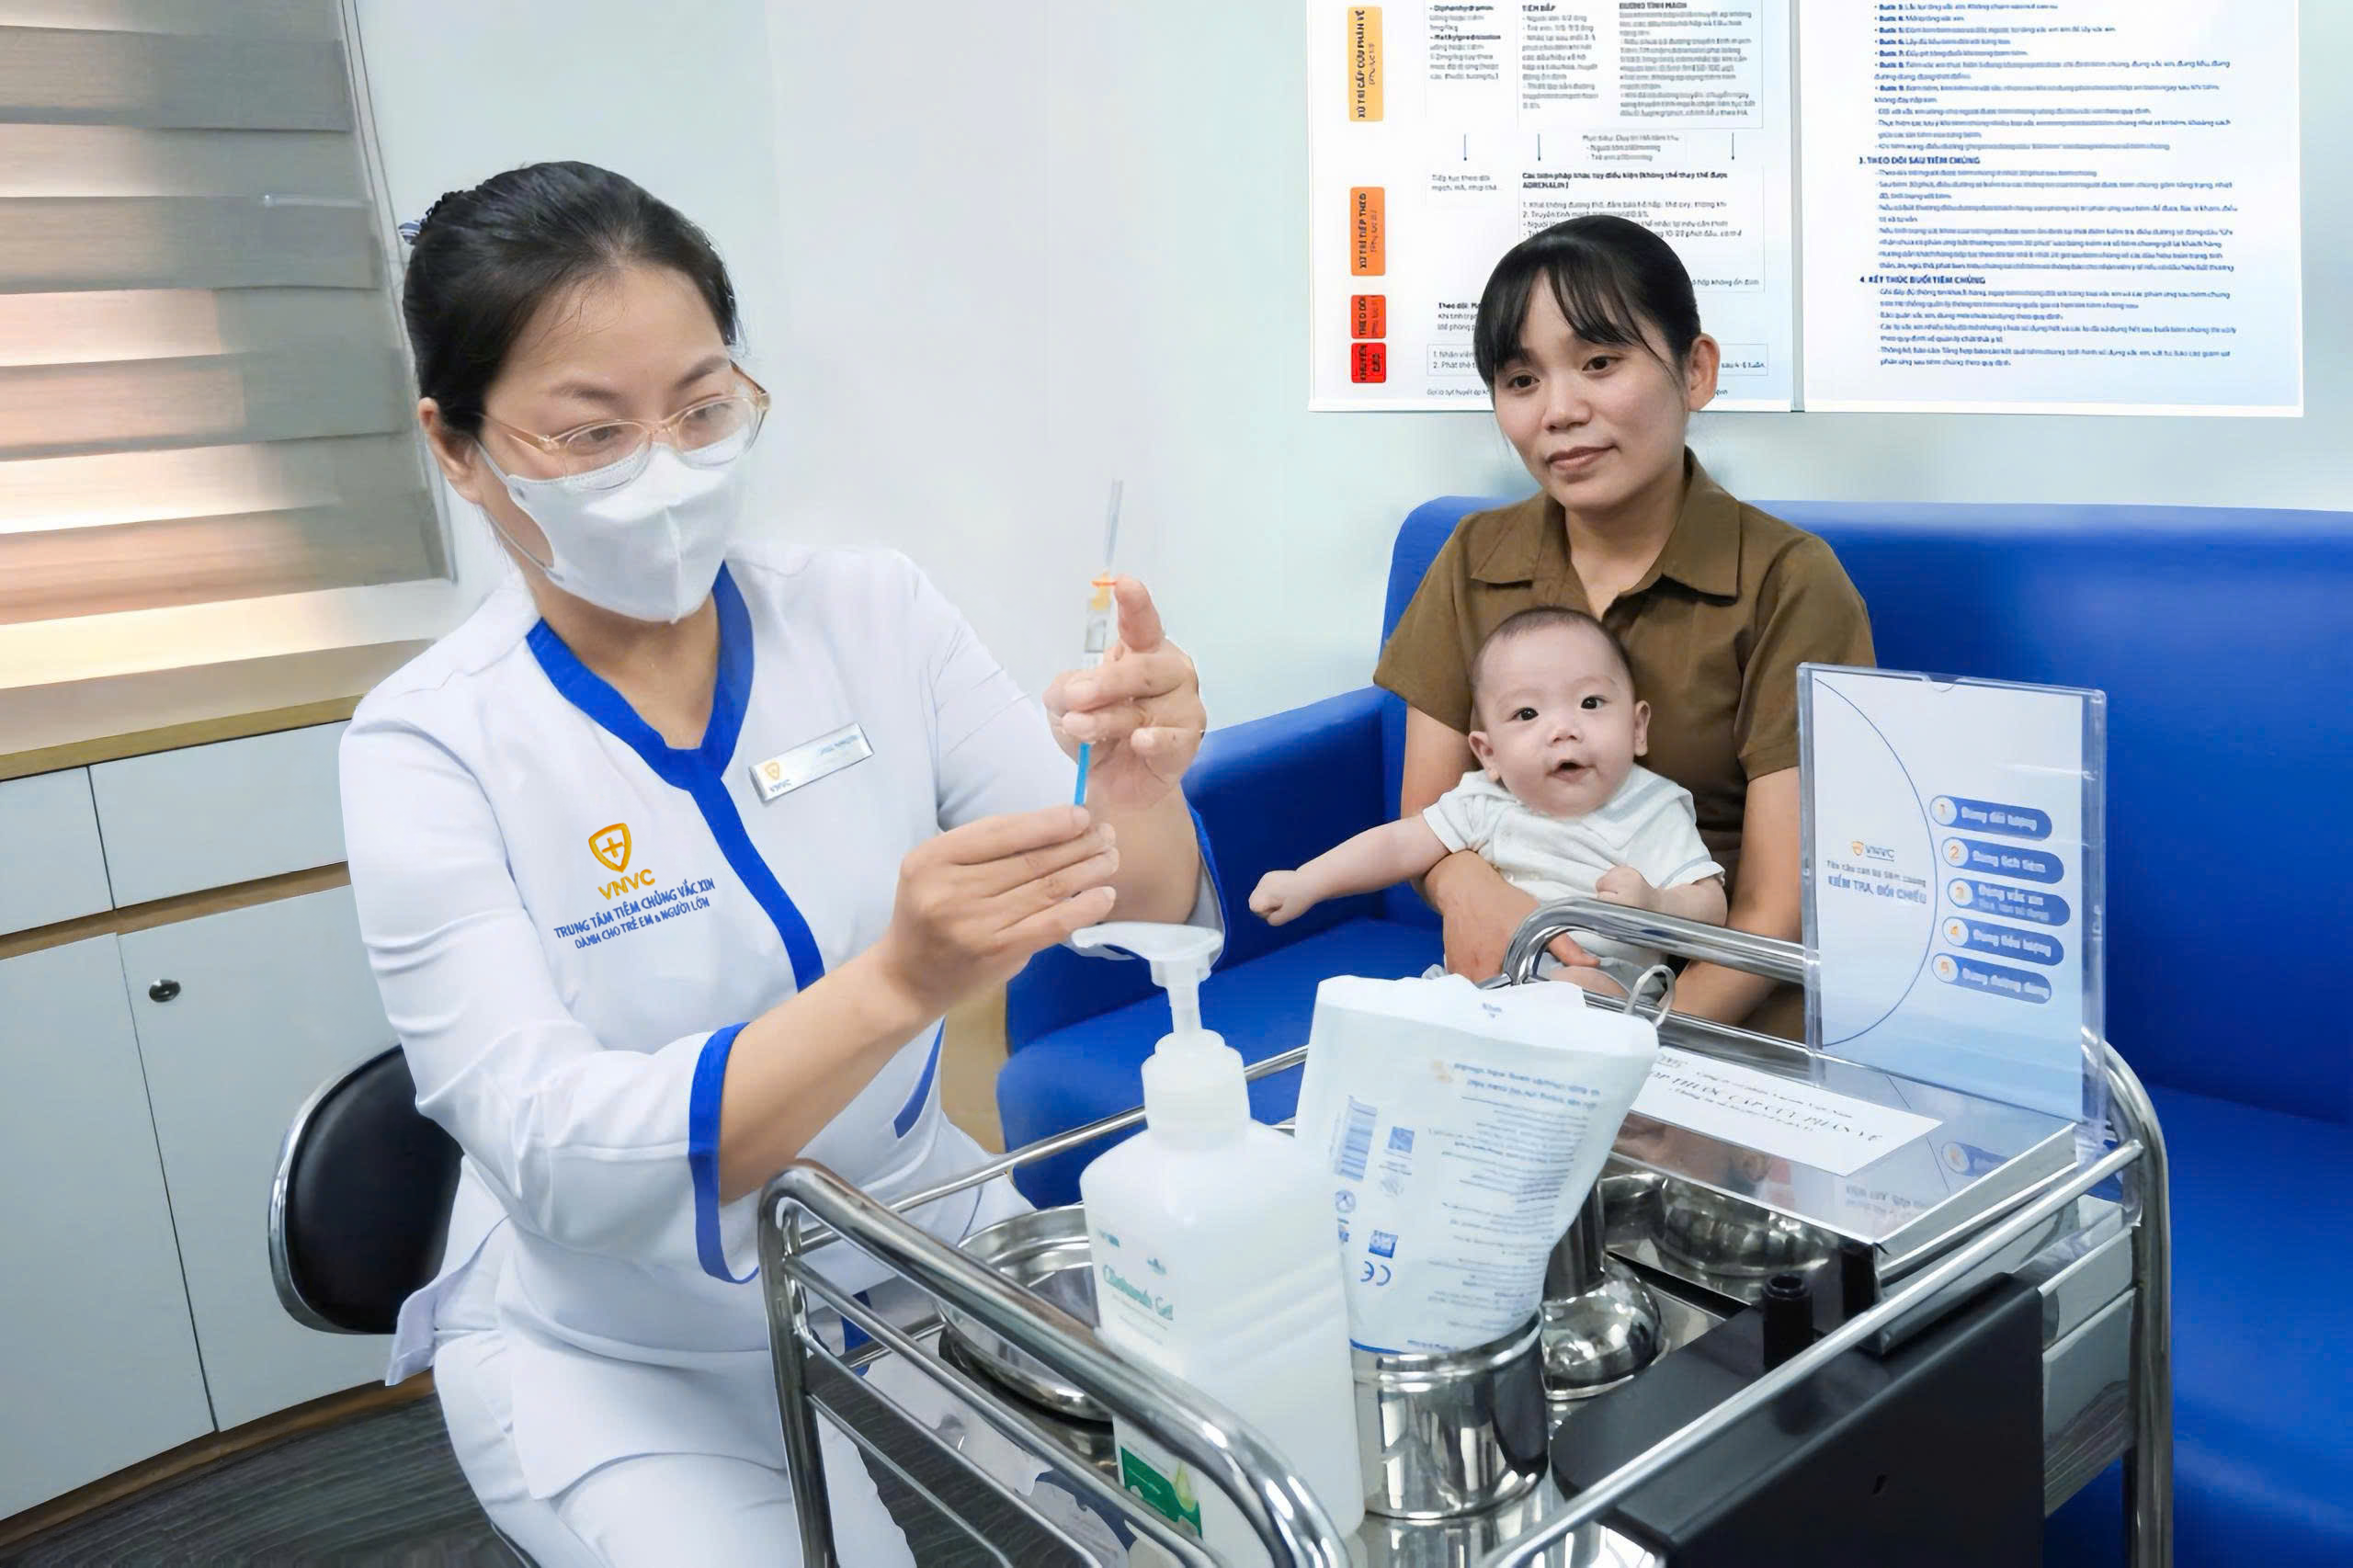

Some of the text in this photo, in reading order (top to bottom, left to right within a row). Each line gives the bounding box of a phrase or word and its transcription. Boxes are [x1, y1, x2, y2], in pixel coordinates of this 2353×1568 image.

[1949, 845, 1959, 859] 2
[597, 869, 655, 901] VNVC
[553, 878, 716, 938] TRUNG TÂM TIÊM CHỦNG VẮC XIN
[574, 935, 602, 949] DÀNH
[601, 926, 621, 940] CHO
[620, 915, 640, 933] TRẺ
[639, 914, 654, 927] EM
[660, 901, 691, 921] NGƯỜI
[692, 896, 710, 911] LỚN
[1359, 1260, 1392, 1287] CE
